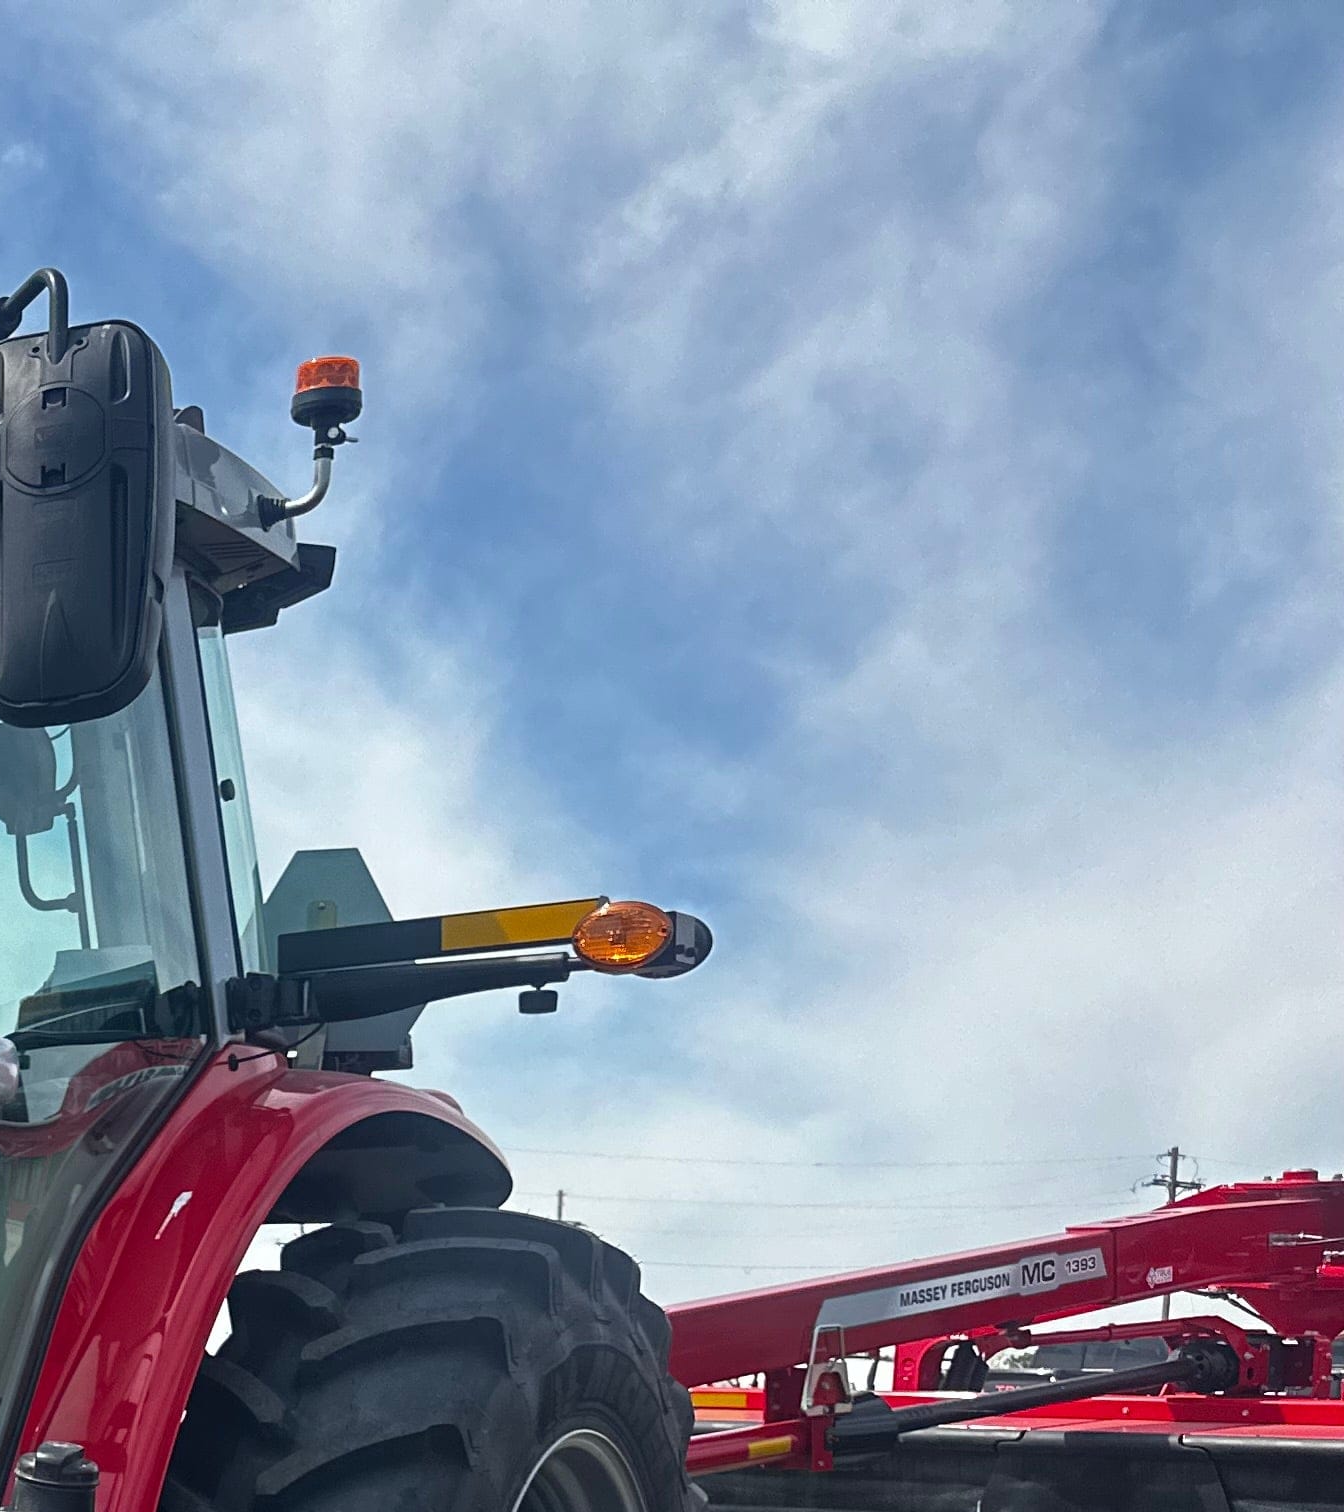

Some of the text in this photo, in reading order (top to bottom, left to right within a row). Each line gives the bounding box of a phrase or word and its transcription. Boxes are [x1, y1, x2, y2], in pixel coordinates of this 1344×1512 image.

[899, 1255, 1097, 1308] MASSEY FERGUSON MC 1393
